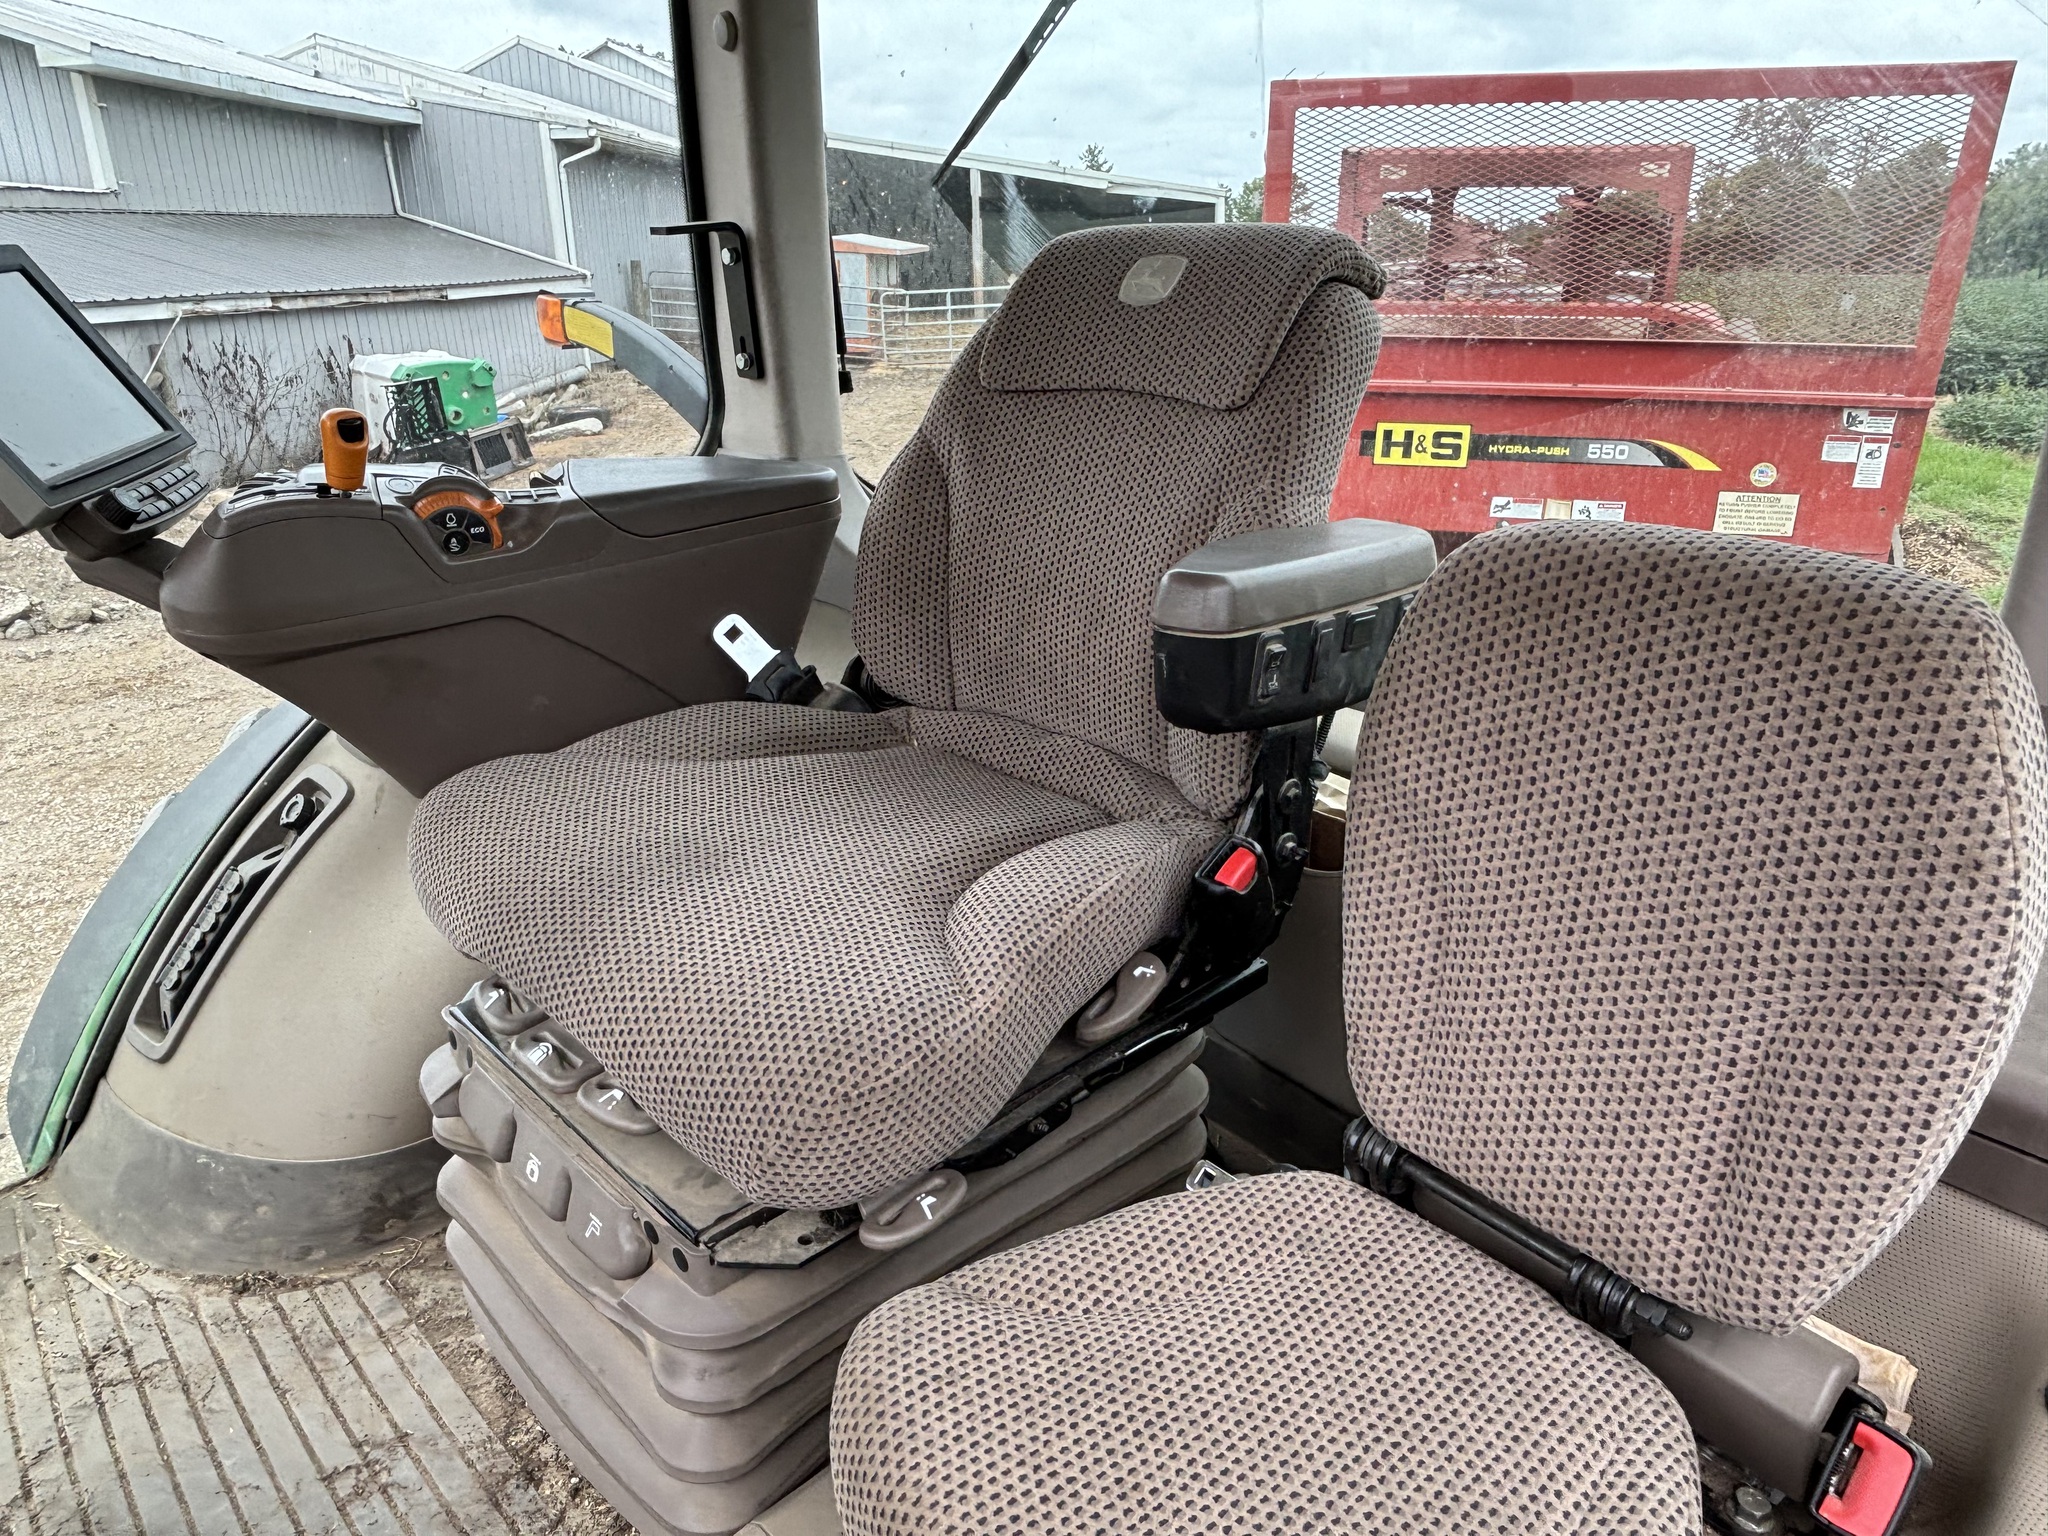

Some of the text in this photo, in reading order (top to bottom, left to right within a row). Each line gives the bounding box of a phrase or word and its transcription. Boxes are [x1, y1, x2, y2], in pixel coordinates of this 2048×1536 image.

[1381, 429, 1463, 460] H&S
[1488, 443, 1629, 460] HYDRA-PUSH 550
[1735, 495, 1782, 503] ATTENTION
[470, 526, 485, 534] ECO
